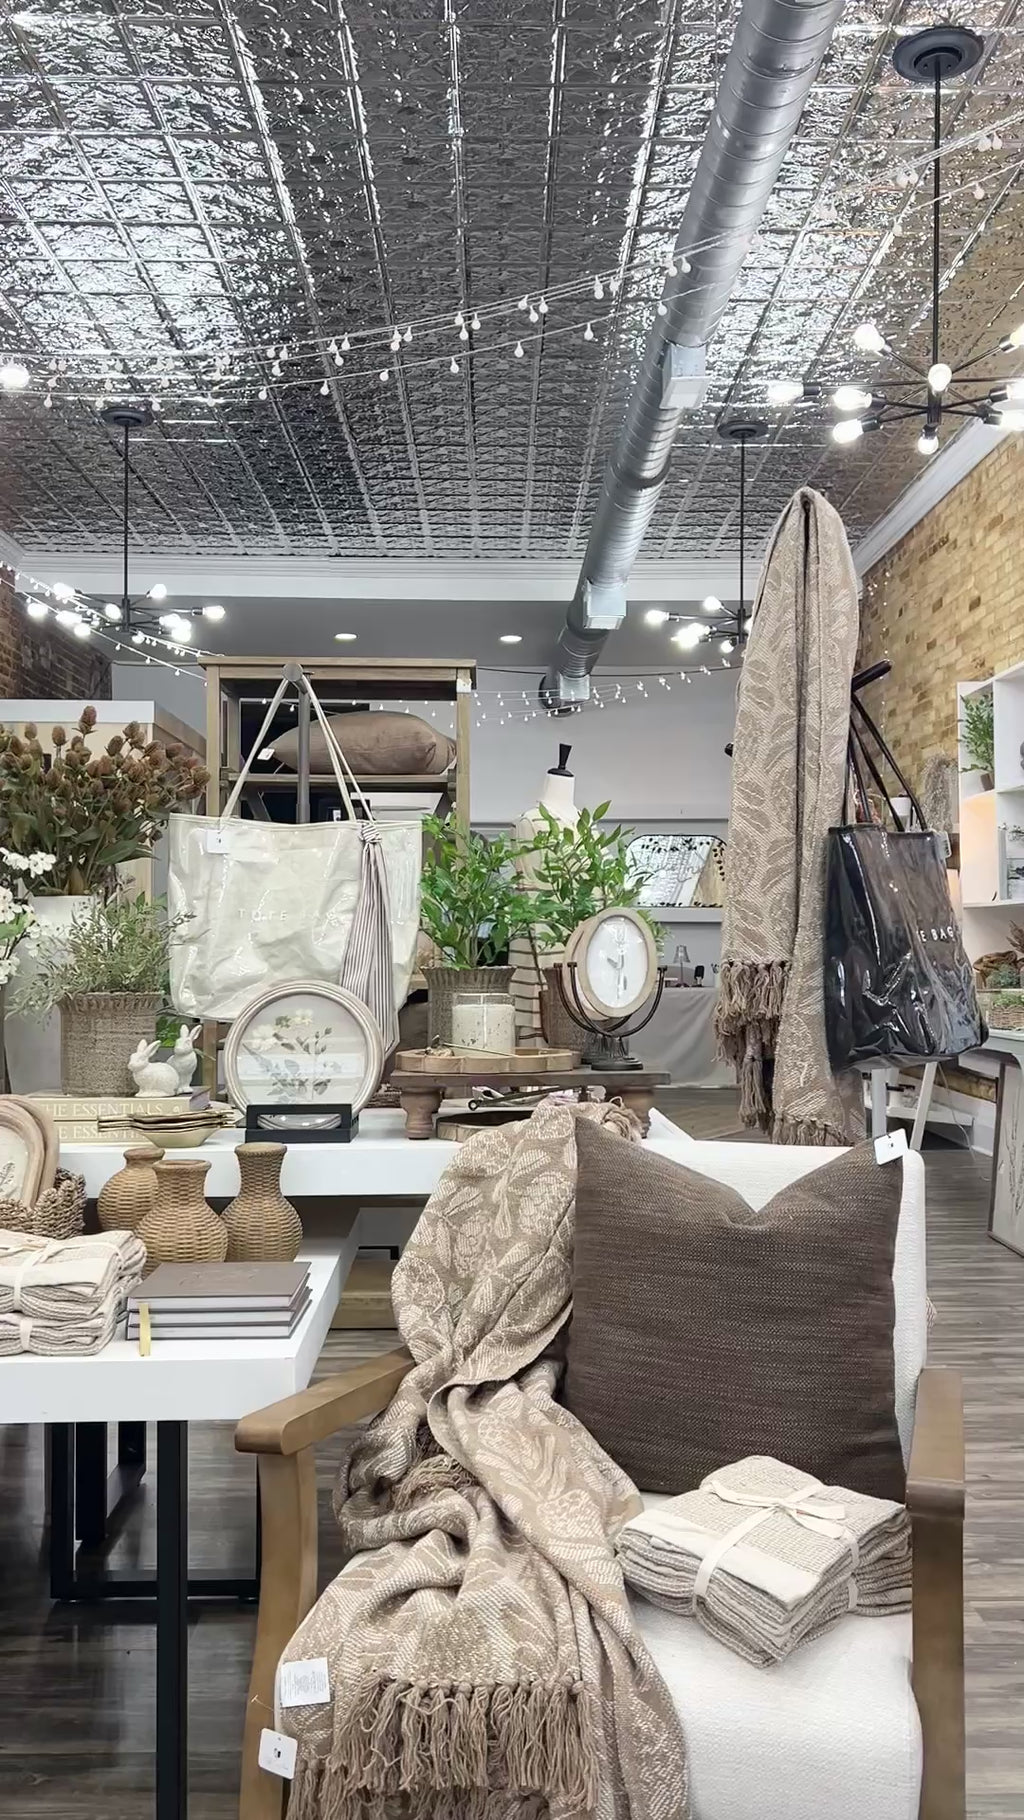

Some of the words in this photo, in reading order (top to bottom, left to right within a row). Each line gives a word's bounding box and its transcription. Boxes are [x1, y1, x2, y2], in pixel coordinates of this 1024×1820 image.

[238, 907, 289, 921] TOTE
[930, 925, 956, 941] BAG
[73, 1103, 163, 1117] ESSENTIALS
